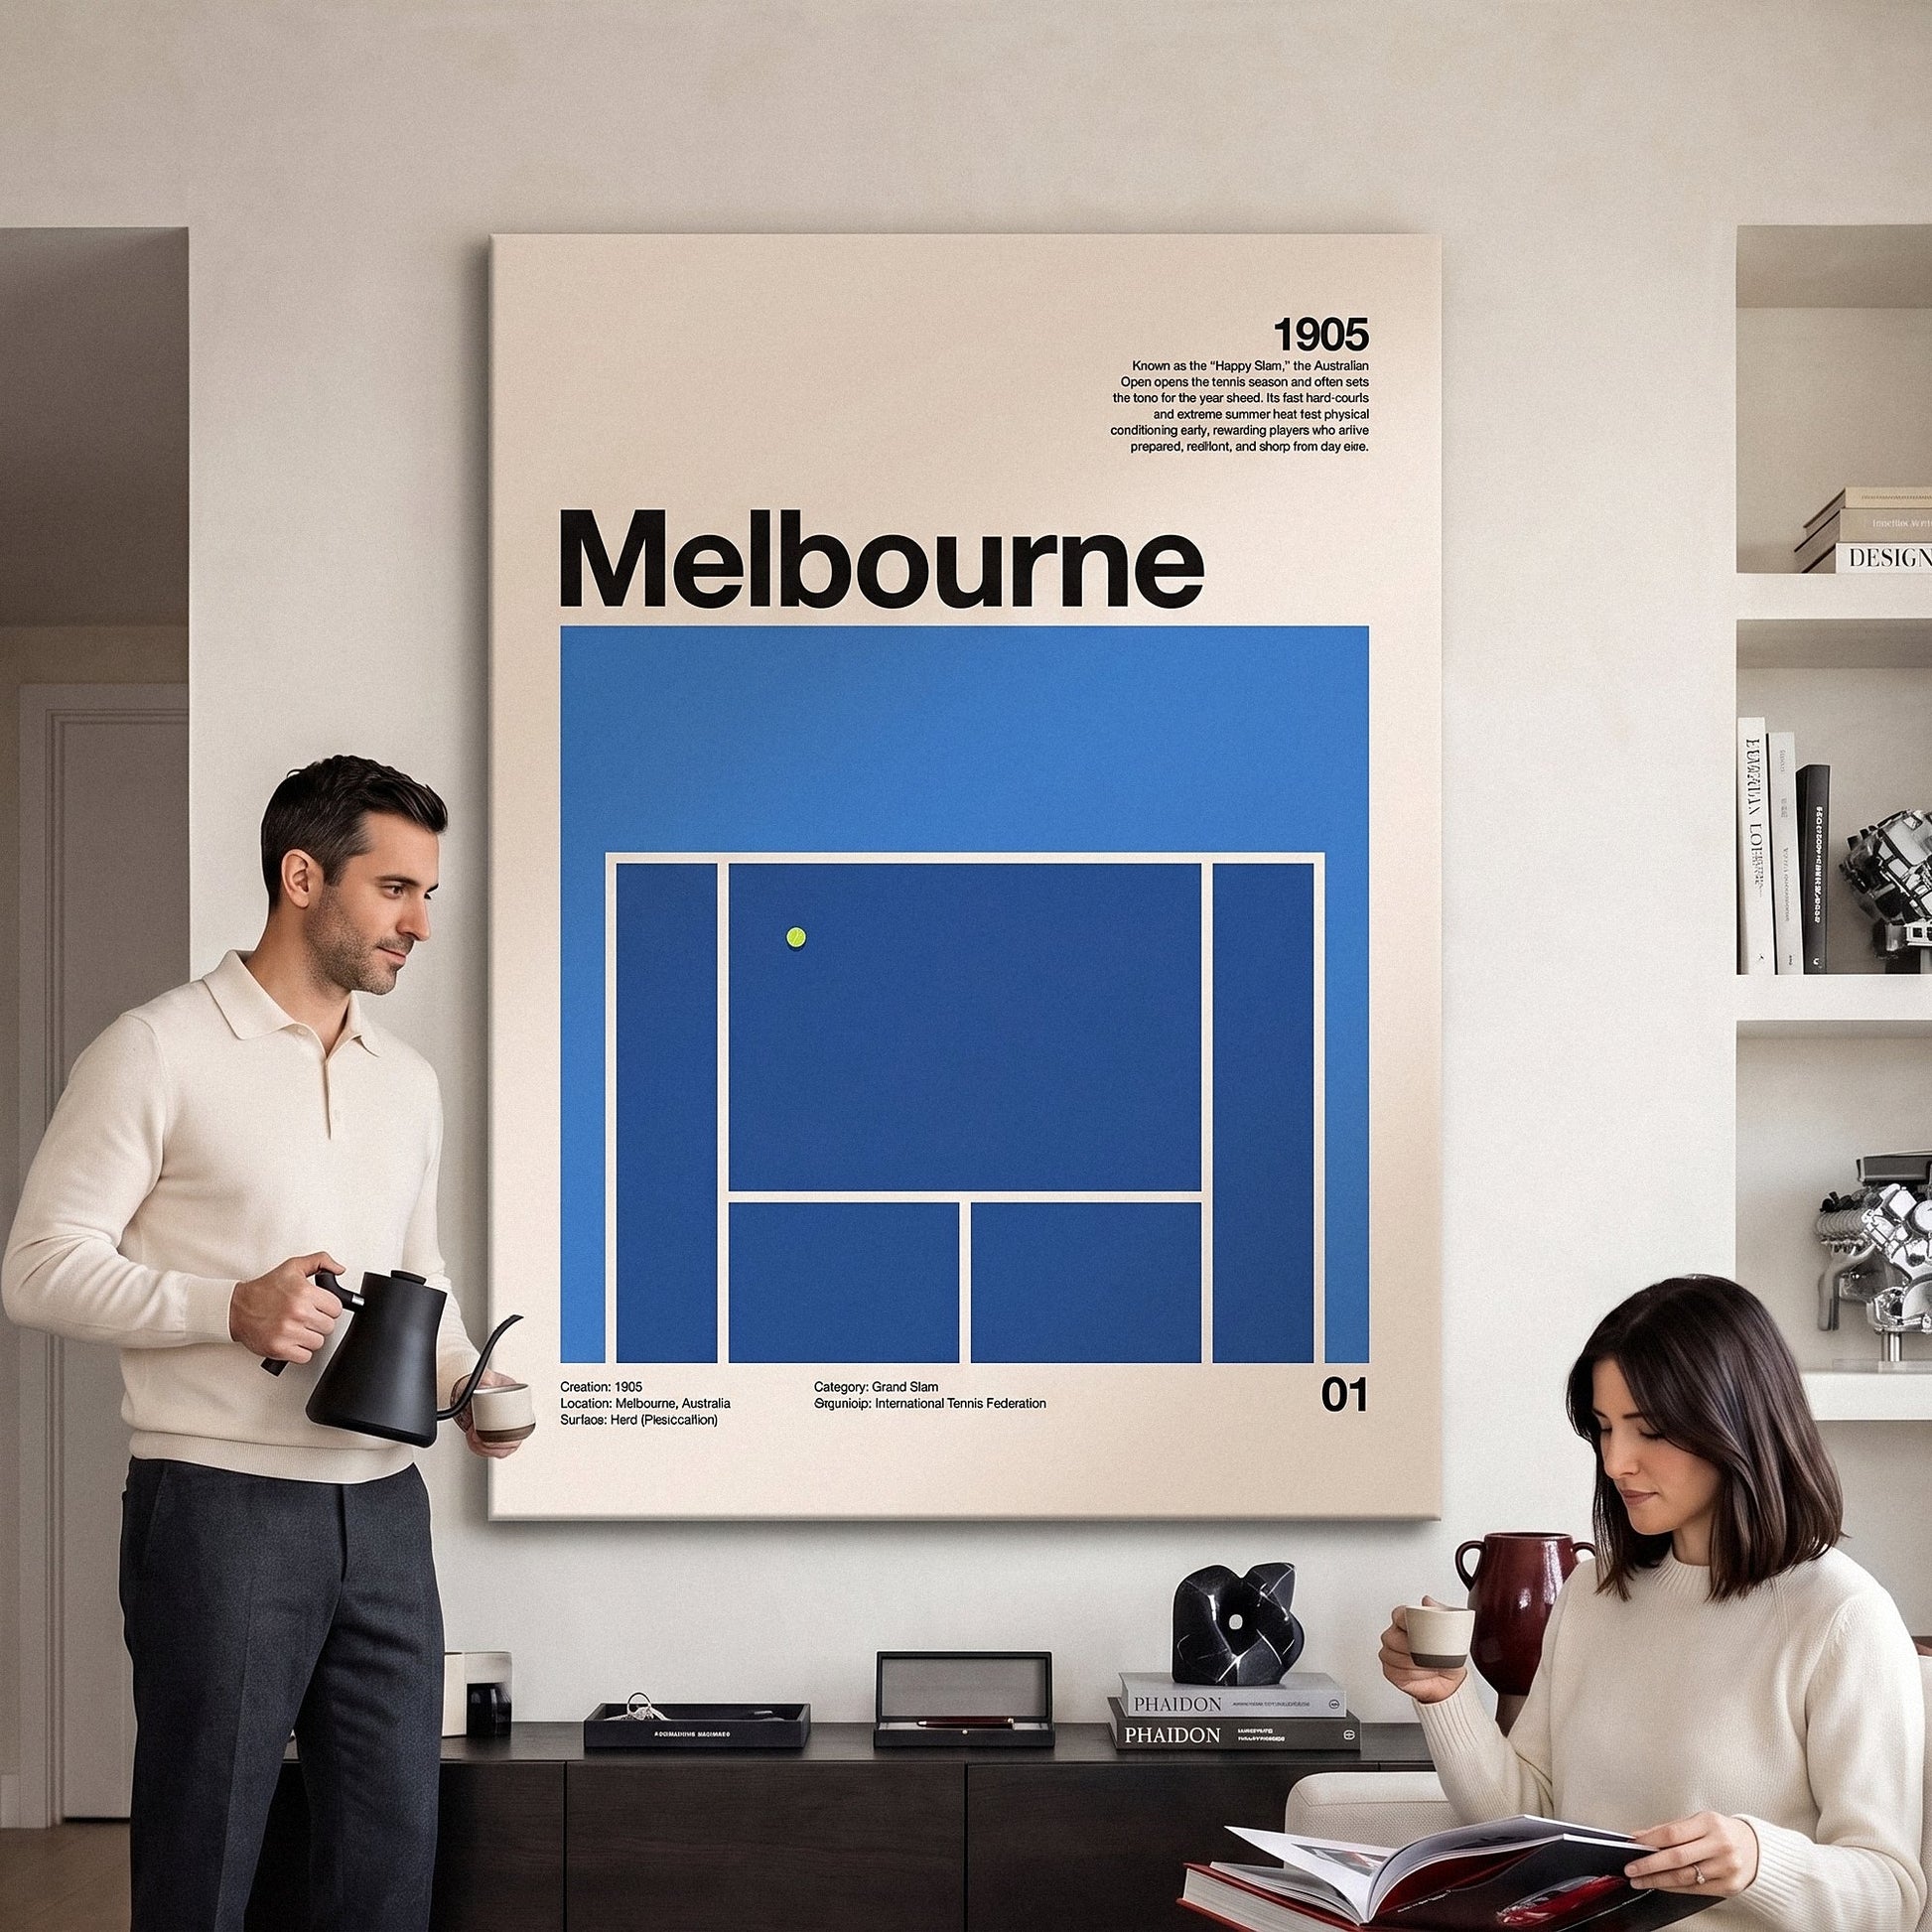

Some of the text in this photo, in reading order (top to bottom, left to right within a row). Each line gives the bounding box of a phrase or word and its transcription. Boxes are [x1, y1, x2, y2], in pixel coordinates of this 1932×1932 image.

[1274, 317, 1370, 351] 1905
[1132, 360, 1171, 371] Known
[1173, 362, 1187, 371] as
[1188, 360, 1207, 371] the
[1293, 360, 1312, 371] the
[1313, 360, 1369, 371] Australian
[1121, 376, 1153, 389] Open
[1154, 379, 1189, 389] opens
[1190, 377, 1210, 387] the
[1212, 376, 1246, 387] tennis
[1291, 377, 1312, 387] and
[1313, 376, 1343, 387] often
[1345, 377, 1370, 387] sets
[1112, 392, 1131, 403] the
[1161, 392, 1176, 403] for
[1178, 392, 1197, 403] the
[1198, 394, 1225, 406] year
[1266, 392, 1281, 403] Its
[1283, 392, 1305, 403] fast
[1153, 409, 1174, 420] and
[1176, 410, 1223, 420] extreme
[1225, 411, 1272, 420] summer
[1273, 409, 1298, 419] heat
[1323, 409, 1370, 422] physical
[1110, 425, 1178, 438] conditioning
[1212, 425, 1267, 438] rewarding
[1269, 425, 1311, 438] players
[1312, 425, 1336, 436] who
[1130, 441, 1184, 455] prepared,
[1235, 441, 1257, 452] and
[1293, 441, 1318, 452] from
[1320, 441, 1342, 454] day
[560, 508, 1205, 610] Melbourne
[560, 1381, 643, 1393] Creation: 1905
[814, 1381, 939, 1394] Category: Grand Slam
[1321, 1376, 1367, 1413] 01
[560, 1398, 732, 1410] Location: Melbourne, Australia
[875, 1398, 945, 1409] International
[947, 1398, 984, 1409] Tennis
[986, 1398, 1046, 1409] Federation
[1134, 1697, 1222, 1712] PHAIDON
[1124, 1726, 1222, 1743] PHAIDON
